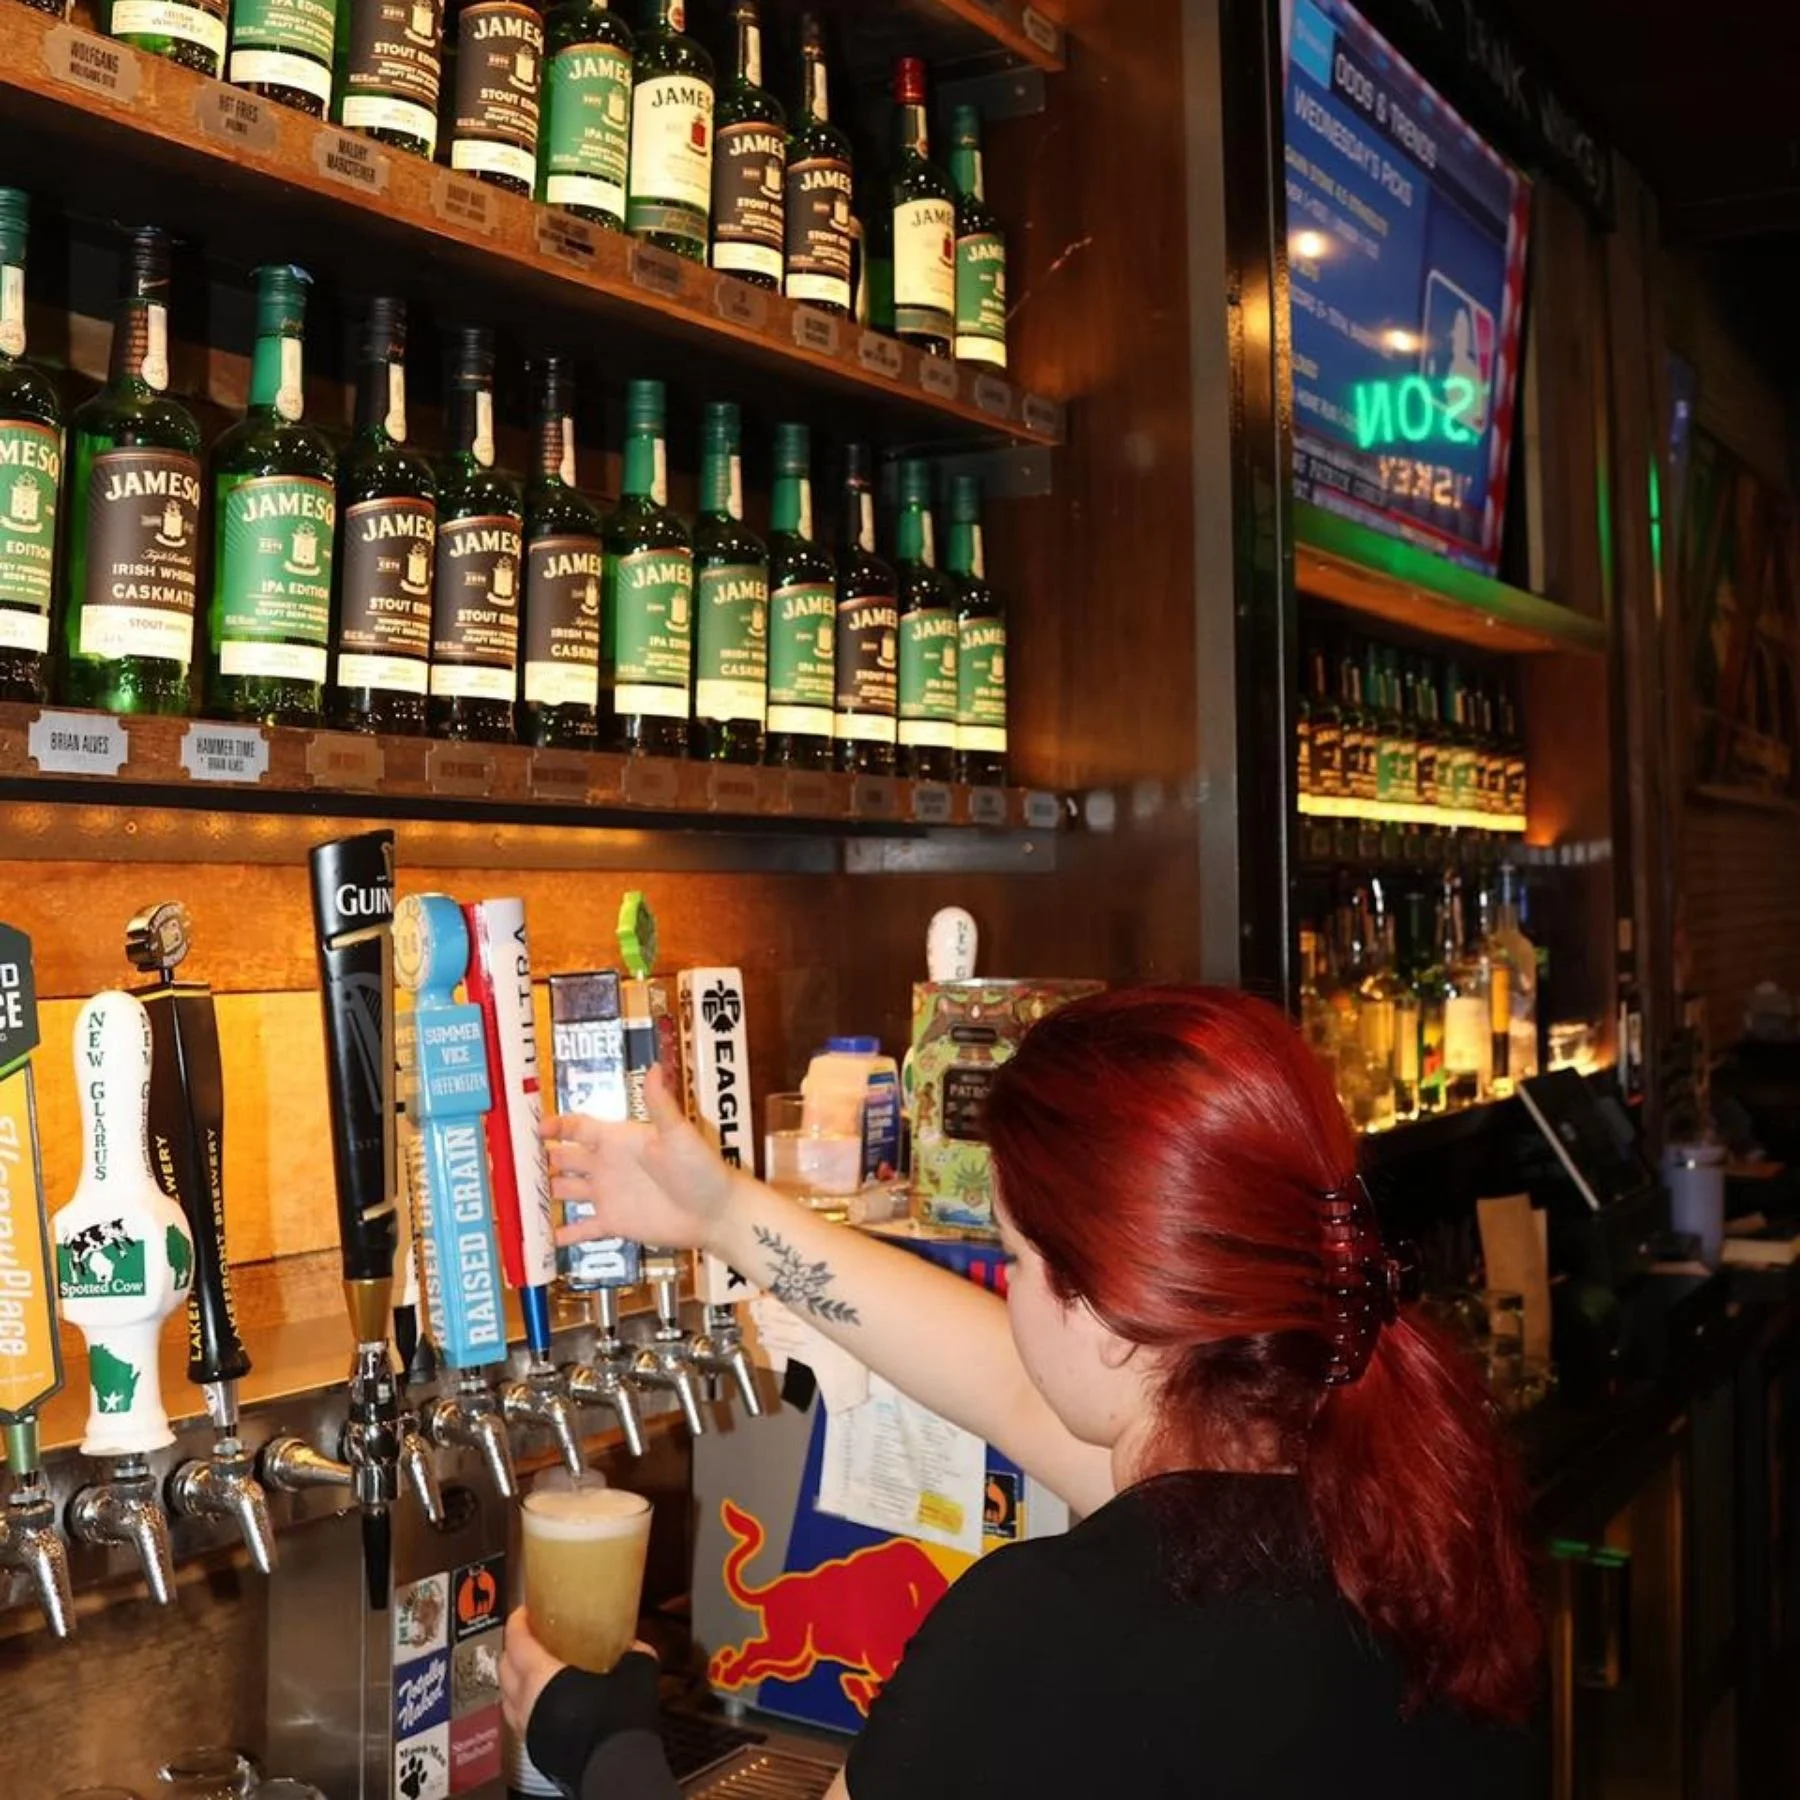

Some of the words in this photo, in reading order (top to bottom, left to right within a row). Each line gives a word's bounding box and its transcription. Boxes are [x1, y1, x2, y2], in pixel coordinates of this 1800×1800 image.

[69, 41, 120, 74] WOLFGANG
[374, 42, 415, 60] STOUT
[480, 88, 519, 106] STOUT
[112, 563, 157, 577] IRISH
[262, 580, 286, 593] IPA
[369, 597, 412, 613] STOUT
[457, 609, 499, 623] STOUT
[50, 732, 79, 752] BRIAN
[81, 735, 110, 755] ALVES
[196, 738, 235, 757] HAMMER
[236, 740, 256, 759] TIME
[513, 924, 536, 1064] ULTRA
[88, 1011, 105, 1067] NEW
[423, 1022, 481, 1045] SUMMER
[441, 1045, 470, 1065] VICE
[555, 1031, 623, 1061] CIDER
[714, 1040, 742, 1170] EAGLE
[89, 1081, 108, 1181] GLARUS
[155, 1134, 181, 1200] WERY
[444, 1126, 484, 1224] GRAIN
[60, 1280, 109, 1299] Spotted
[112, 1279, 144, 1294] Cow
[459, 1231, 499, 1346] RAISED
